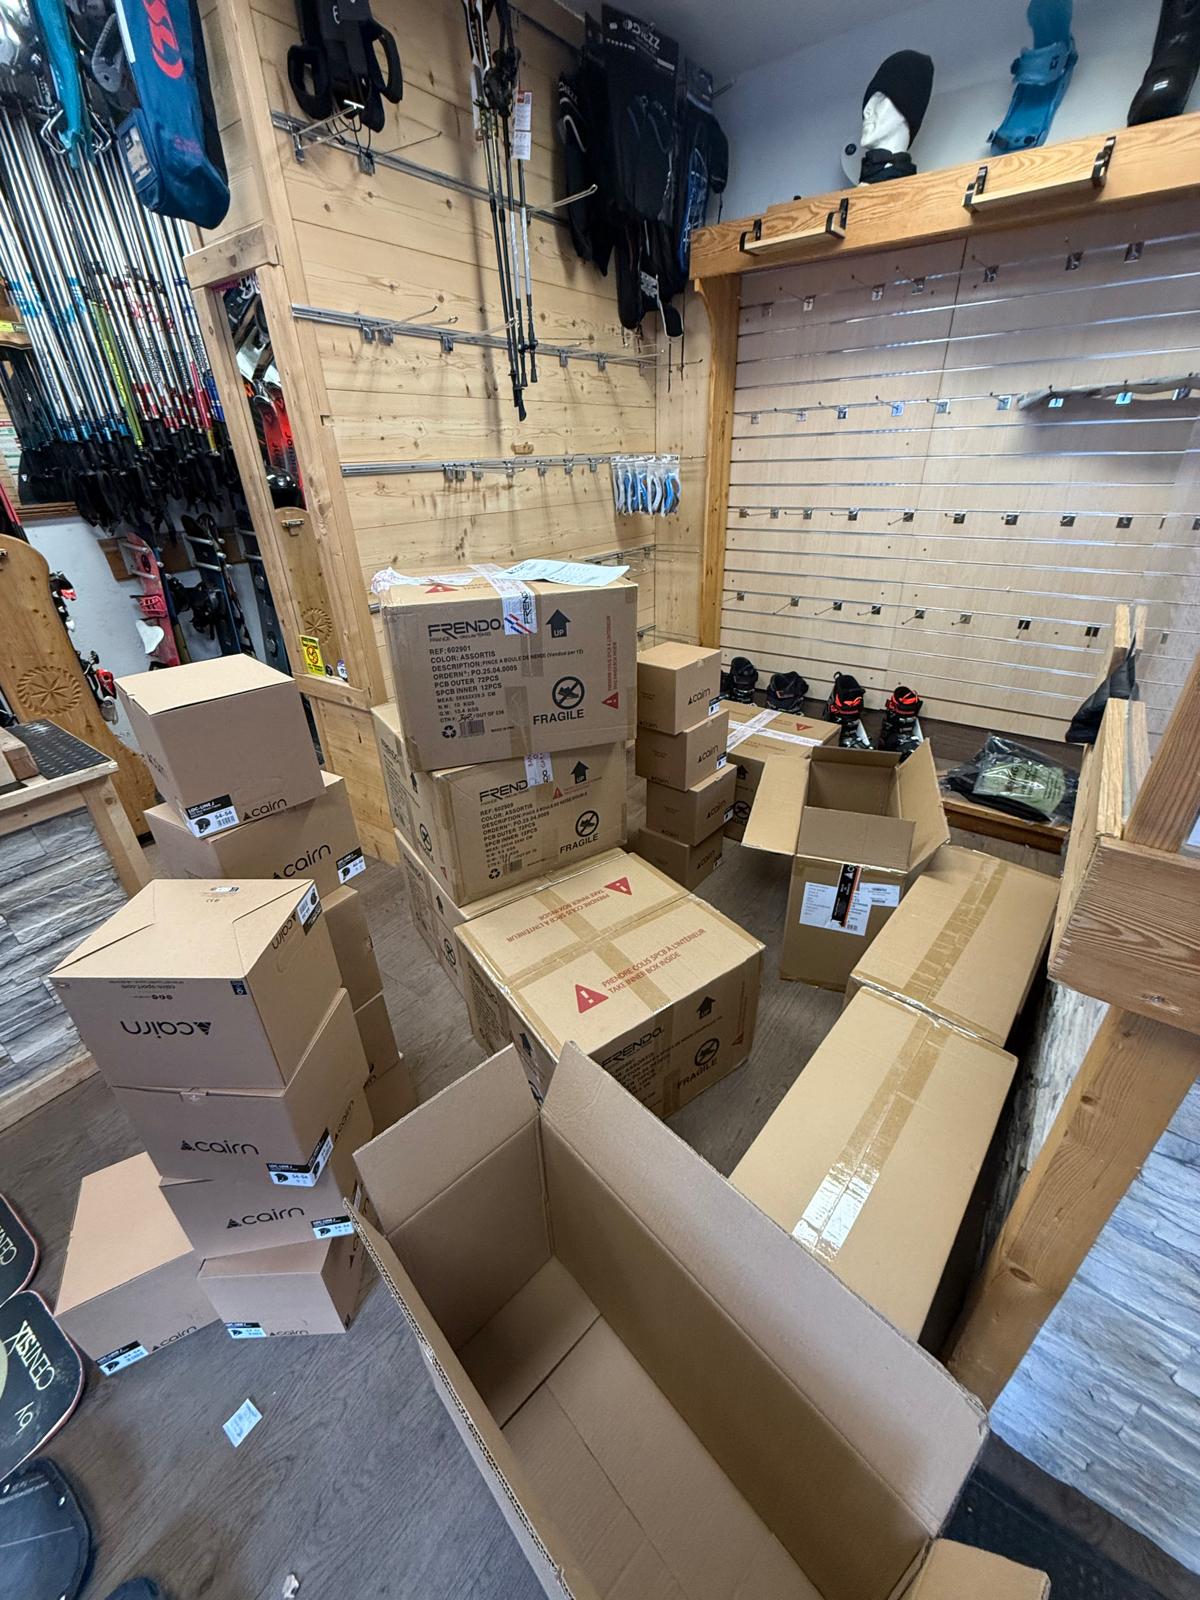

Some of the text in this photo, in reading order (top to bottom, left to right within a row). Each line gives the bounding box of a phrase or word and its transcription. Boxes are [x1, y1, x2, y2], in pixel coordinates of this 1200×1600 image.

[428, 618, 501, 640] FRENDO
[431, 650, 496, 664] COLOR: ASSORTIS
[434, 681, 449, 689] PCB
[477, 675, 499, 683] 72PCS
[435, 688, 455, 697] SPCB
[481, 682, 502, 691] 12PCS
[533, 708, 585, 725] FRAGILE
[480, 780, 528, 802] FREND
[252, 798, 288, 817] cairn
[481, 803, 533, 823] COLOR: ASSORTIS
[560, 832, 600, 854] FRAGILE
[283, 844, 331, 877] cairn
[271, 918, 293, 950] cairn
[602, 966, 634, 988] PRENDRE
[633, 956, 652, 972] COLIS
[651, 947, 669, 961] SPCB
[608, 952, 681, 994] TAKE INNER BOX INSIDE
[120, 1020, 195, 1039] cairn
[677, 1060, 716, 1089] FRAGILE
[195, 1140, 260, 1155] cairn
[242, 1207, 305, 1225] cairn
[160, 1325, 198, 1347] cairn
[14, 1401, 35, 1437] by
